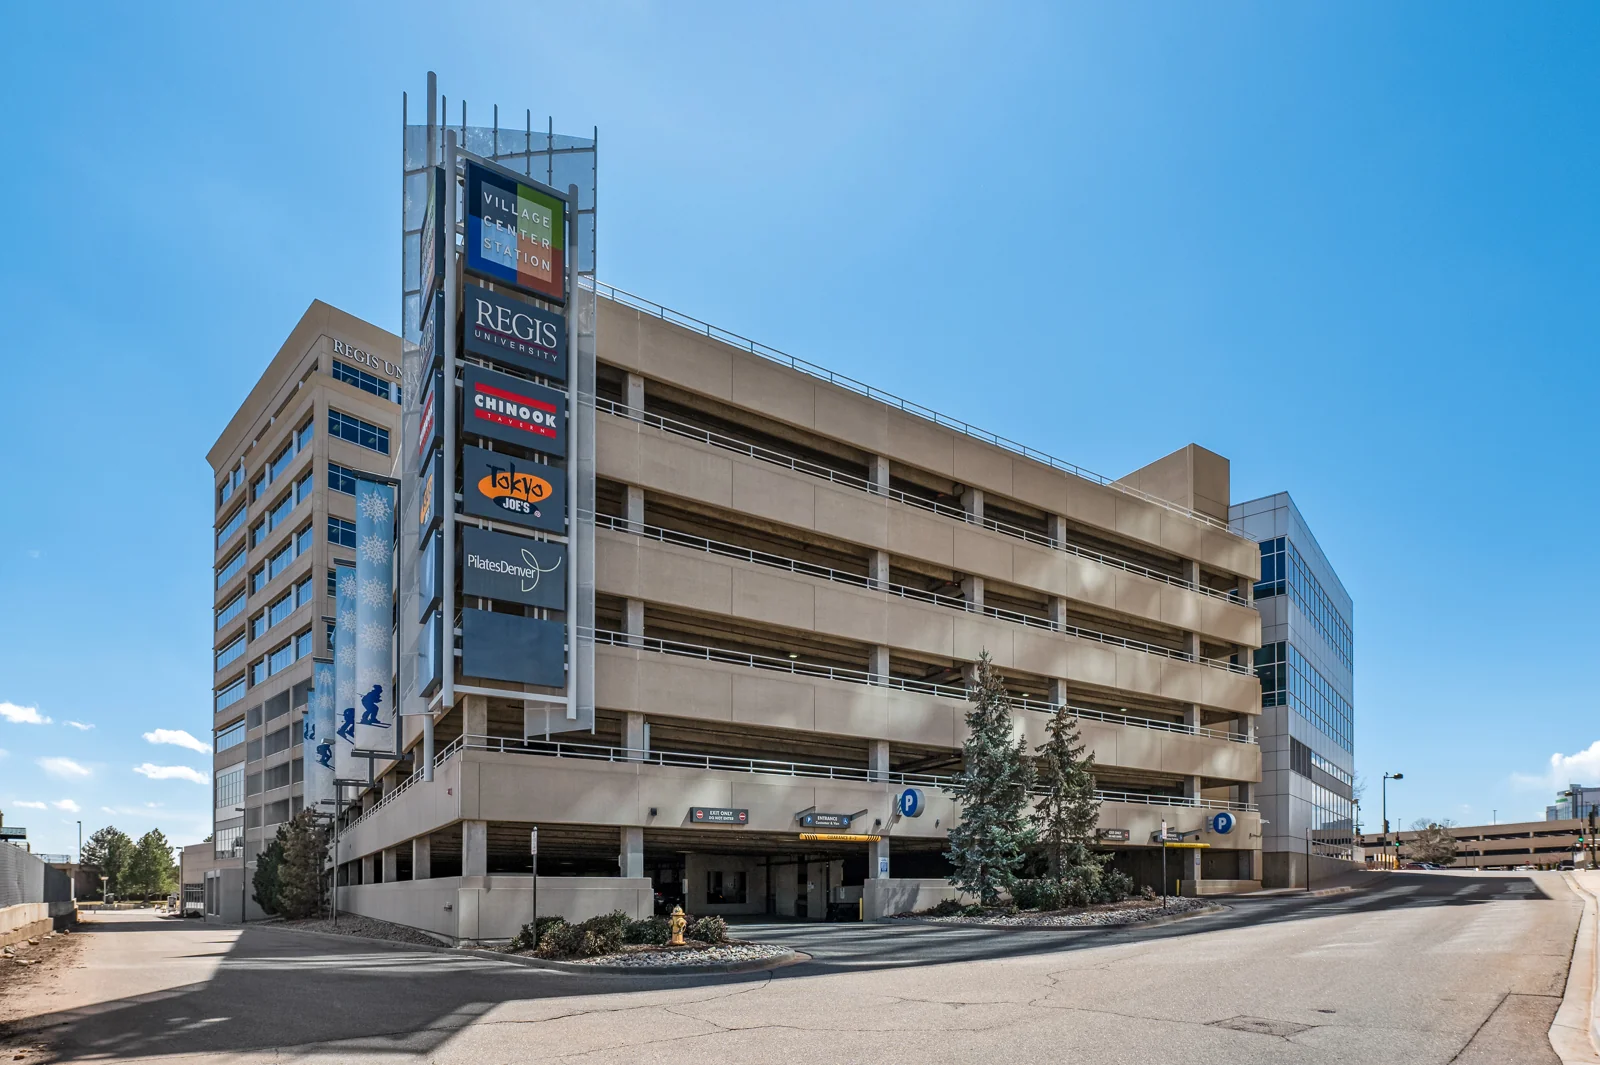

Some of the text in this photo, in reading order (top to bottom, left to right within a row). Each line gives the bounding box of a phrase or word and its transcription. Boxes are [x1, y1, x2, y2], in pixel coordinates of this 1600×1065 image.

[484, 191, 550, 228] VILLAGE
[484, 215, 550, 250] CENTER
[484, 237, 550, 272] STATION
[475, 298, 557, 349] REGIS
[333, 338, 380, 369] REGIS
[474, 329, 558, 362] UNIVERSITY
[474, 394, 556, 428] CHINOOK
[487, 413, 545, 433] TAVERN
[485, 461, 543, 502] Tokyo
[502, 497, 530, 513] JOE'S
[467, 554, 536, 580] PilatesDenver
[905, 794, 913, 811] P
[1218, 817, 1227, 830] P
